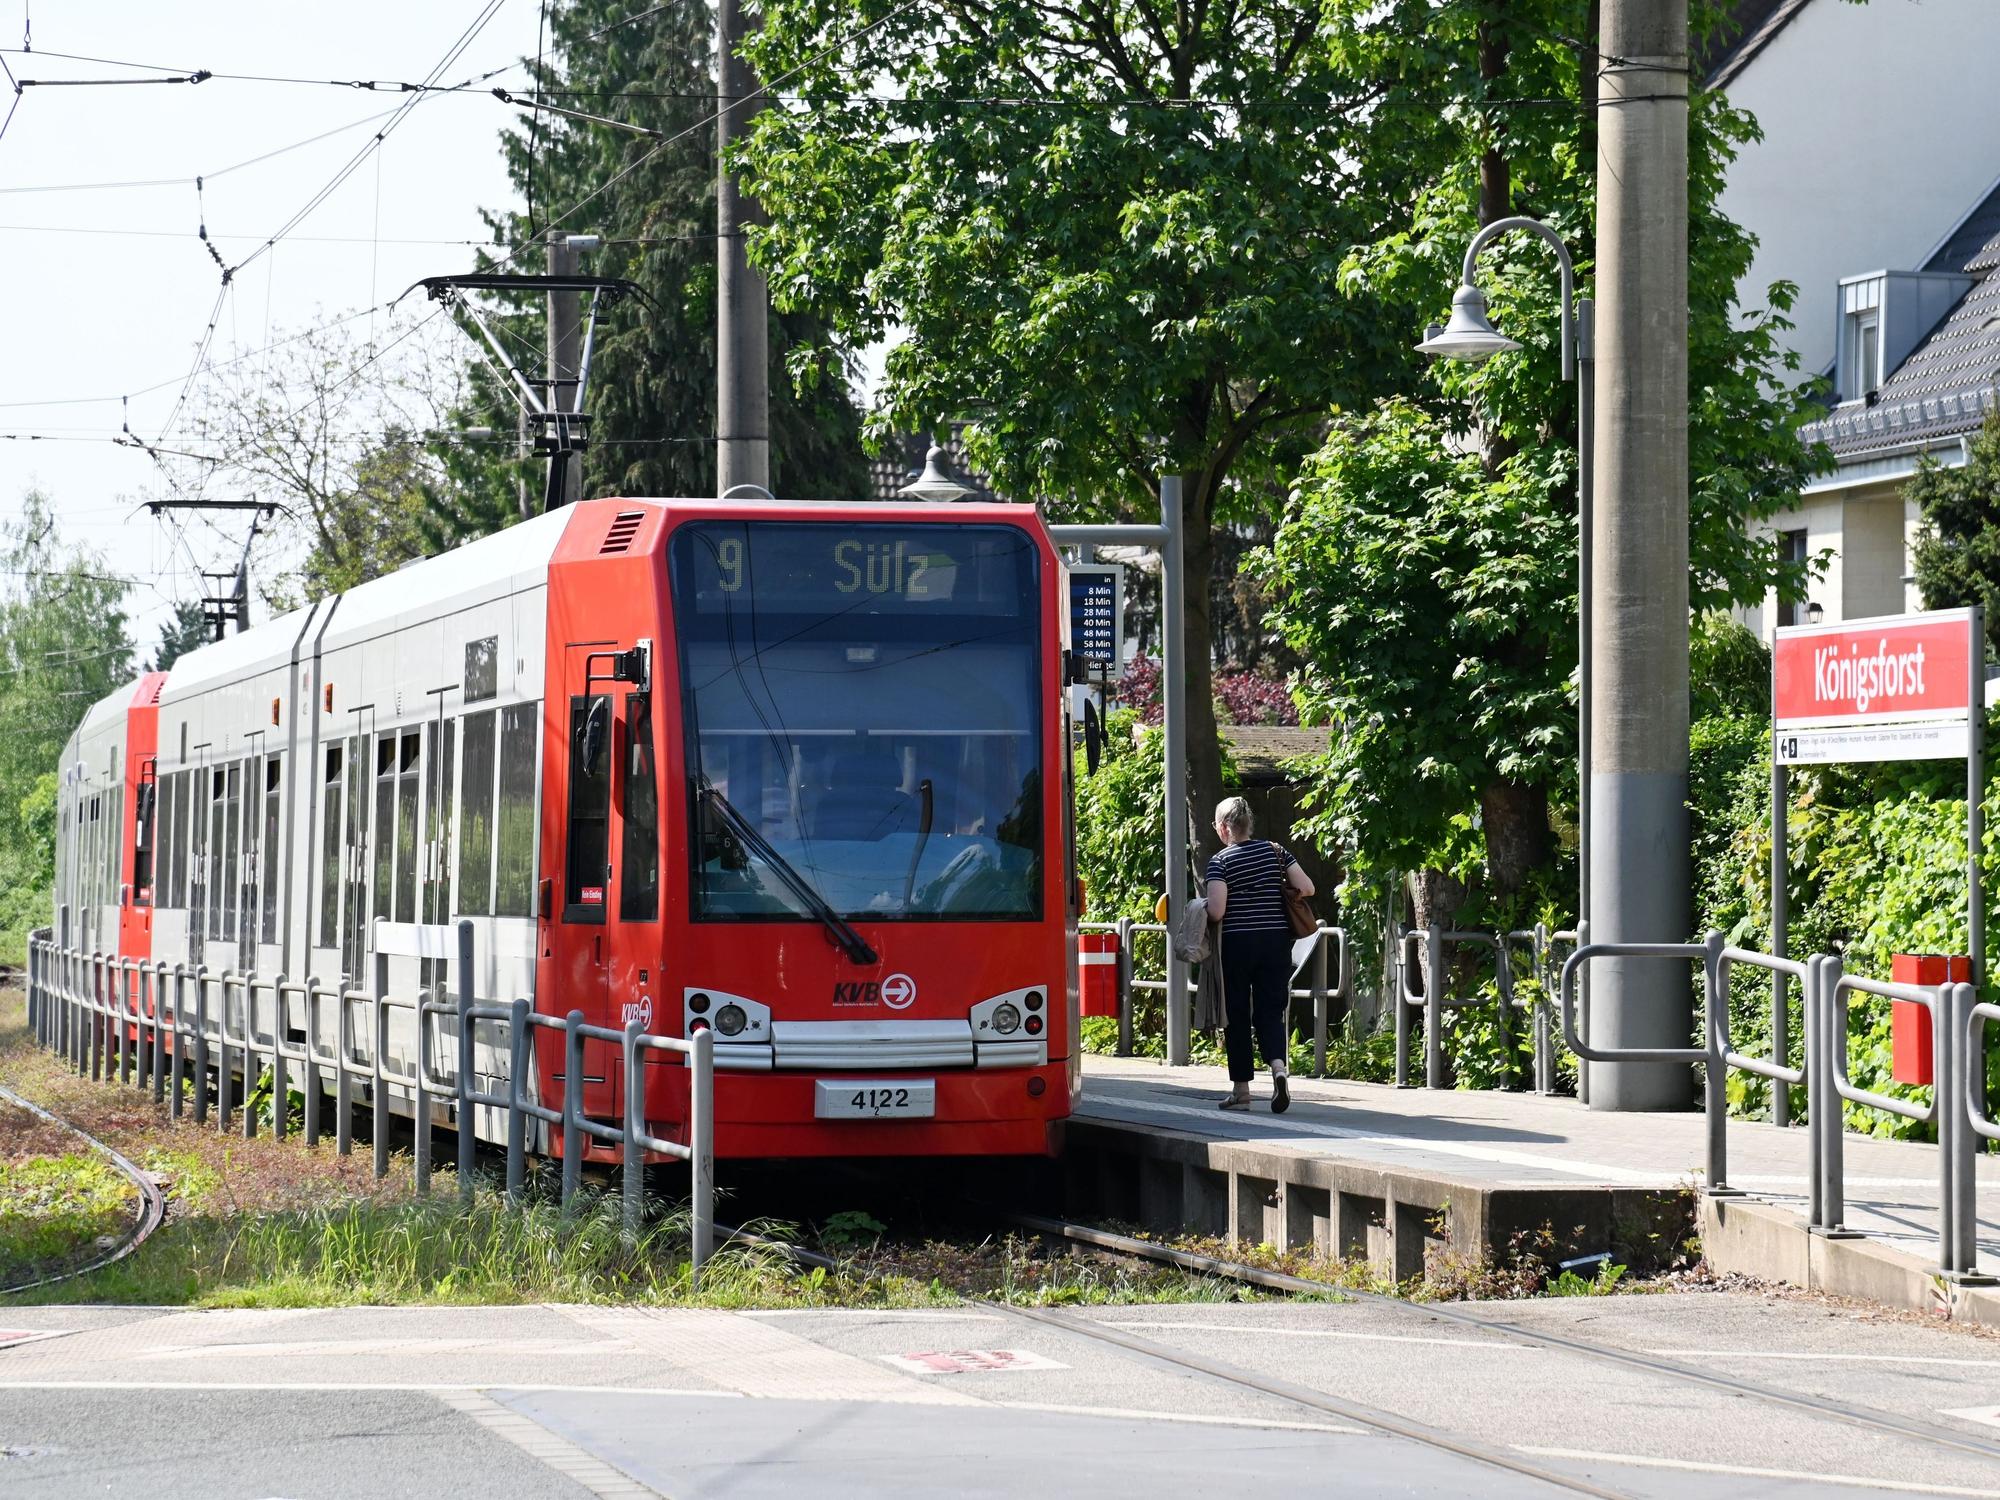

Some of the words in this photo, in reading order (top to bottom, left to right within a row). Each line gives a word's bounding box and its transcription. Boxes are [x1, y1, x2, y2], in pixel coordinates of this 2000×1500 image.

[719, 538, 743, 592] 9
[834, 539, 929, 593] Sülz
[1088, 587, 1094, 595] 8
[1095, 587, 1111, 595] Min
[1083, 598, 1094, 606] 18
[1095, 598, 1111, 606] Min
[1095, 608, 1111, 616] Min
[1083, 619, 1094, 627] 40
[1095, 619, 1111, 627] Min
[1083, 640, 1094, 648] 58
[1095, 640, 1111, 648] Min
[1095, 650, 1111, 658] Min
[1815, 637, 1925, 713] Königsforst
[833, 982, 880, 1003] KVB
[621, 1003, 640, 1023] KVB
[851, 1088, 909, 1110] 4122
[874, 1106, 880, 1116] 2
